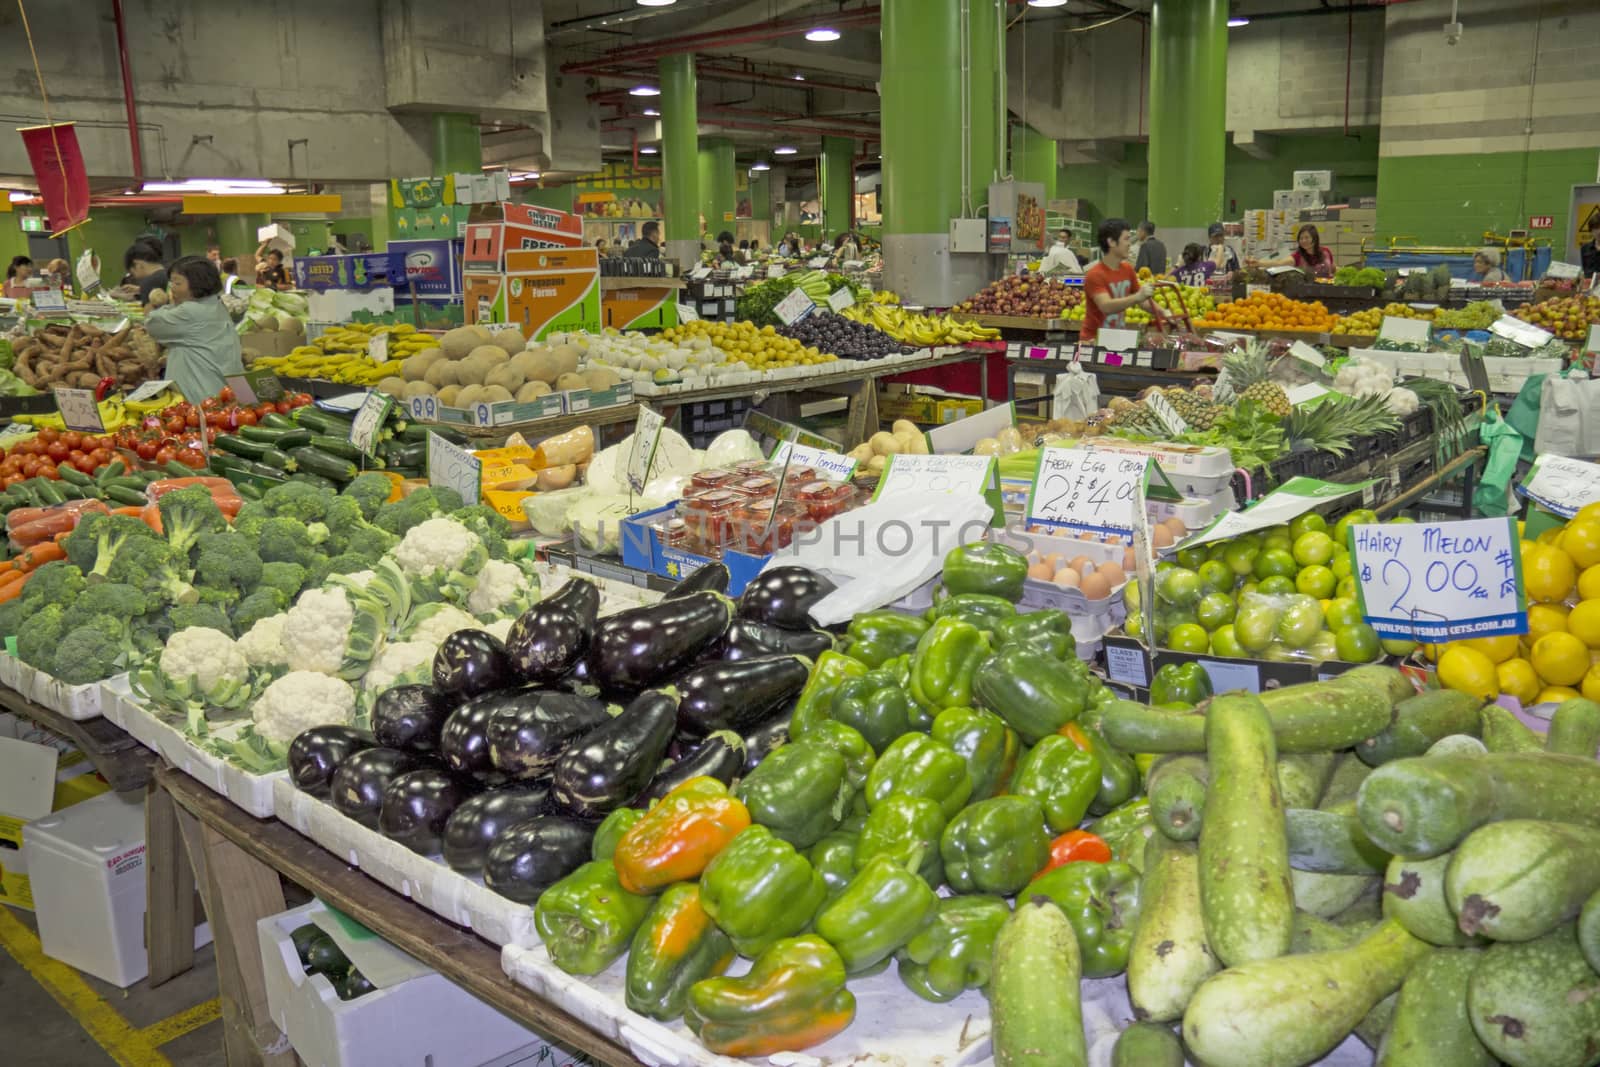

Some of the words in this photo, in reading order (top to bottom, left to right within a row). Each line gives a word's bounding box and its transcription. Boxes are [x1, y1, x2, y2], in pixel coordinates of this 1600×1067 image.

[1043, 450, 1074, 473] FRESH
[1040, 474, 1070, 512] 2
[1422, 527, 1492, 555] MELON
[1370, 617, 1517, 637] WWW.PADYSMARKETS.COM.AU
